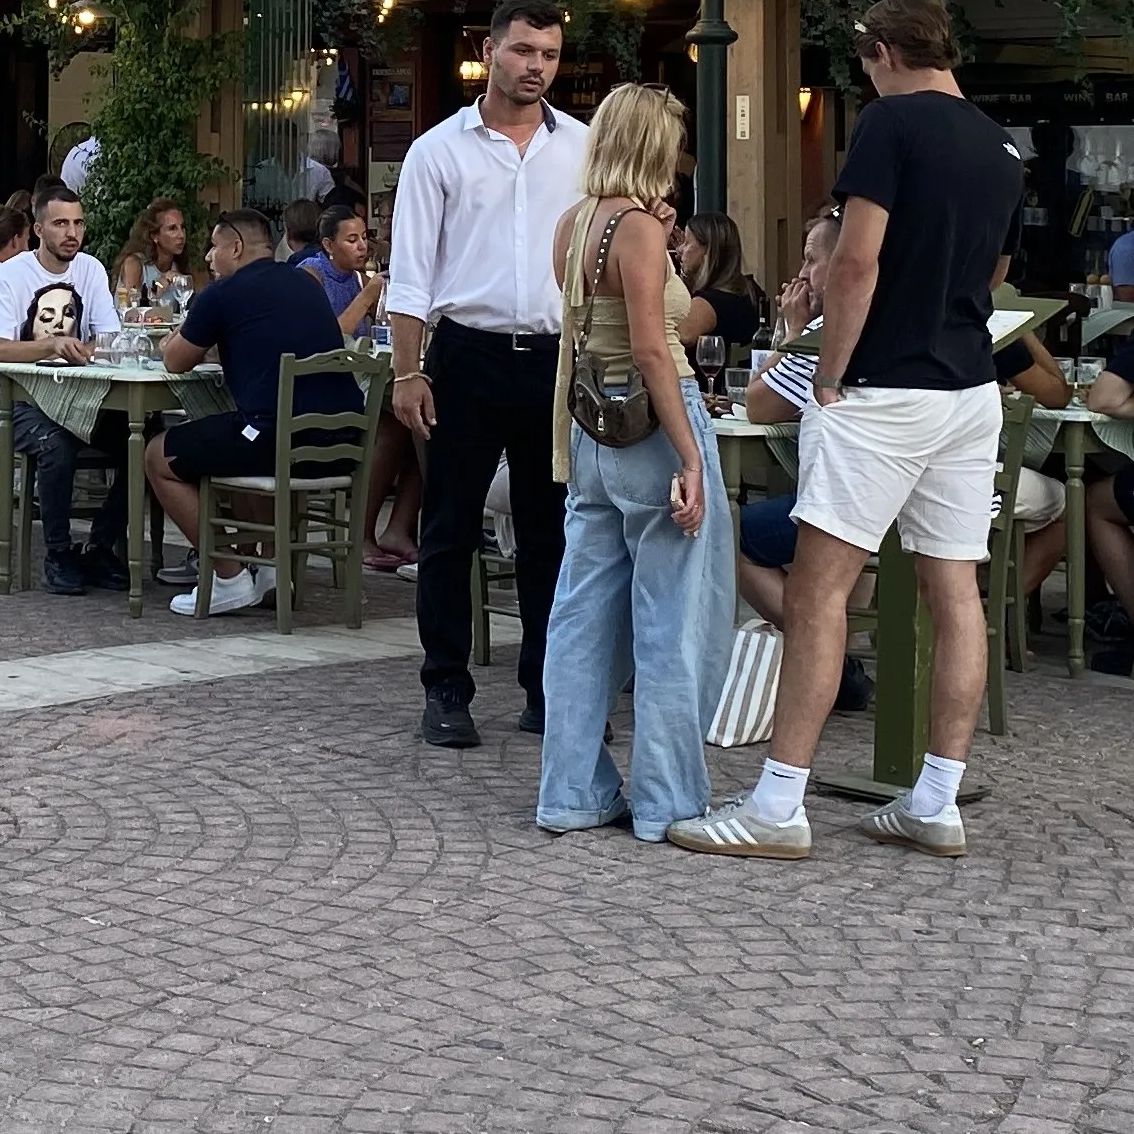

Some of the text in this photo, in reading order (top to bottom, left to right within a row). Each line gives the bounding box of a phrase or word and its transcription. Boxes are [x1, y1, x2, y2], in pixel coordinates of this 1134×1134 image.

[970, 93, 1032, 104] WINE BAR
[1105, 91, 1129, 103] BAR
